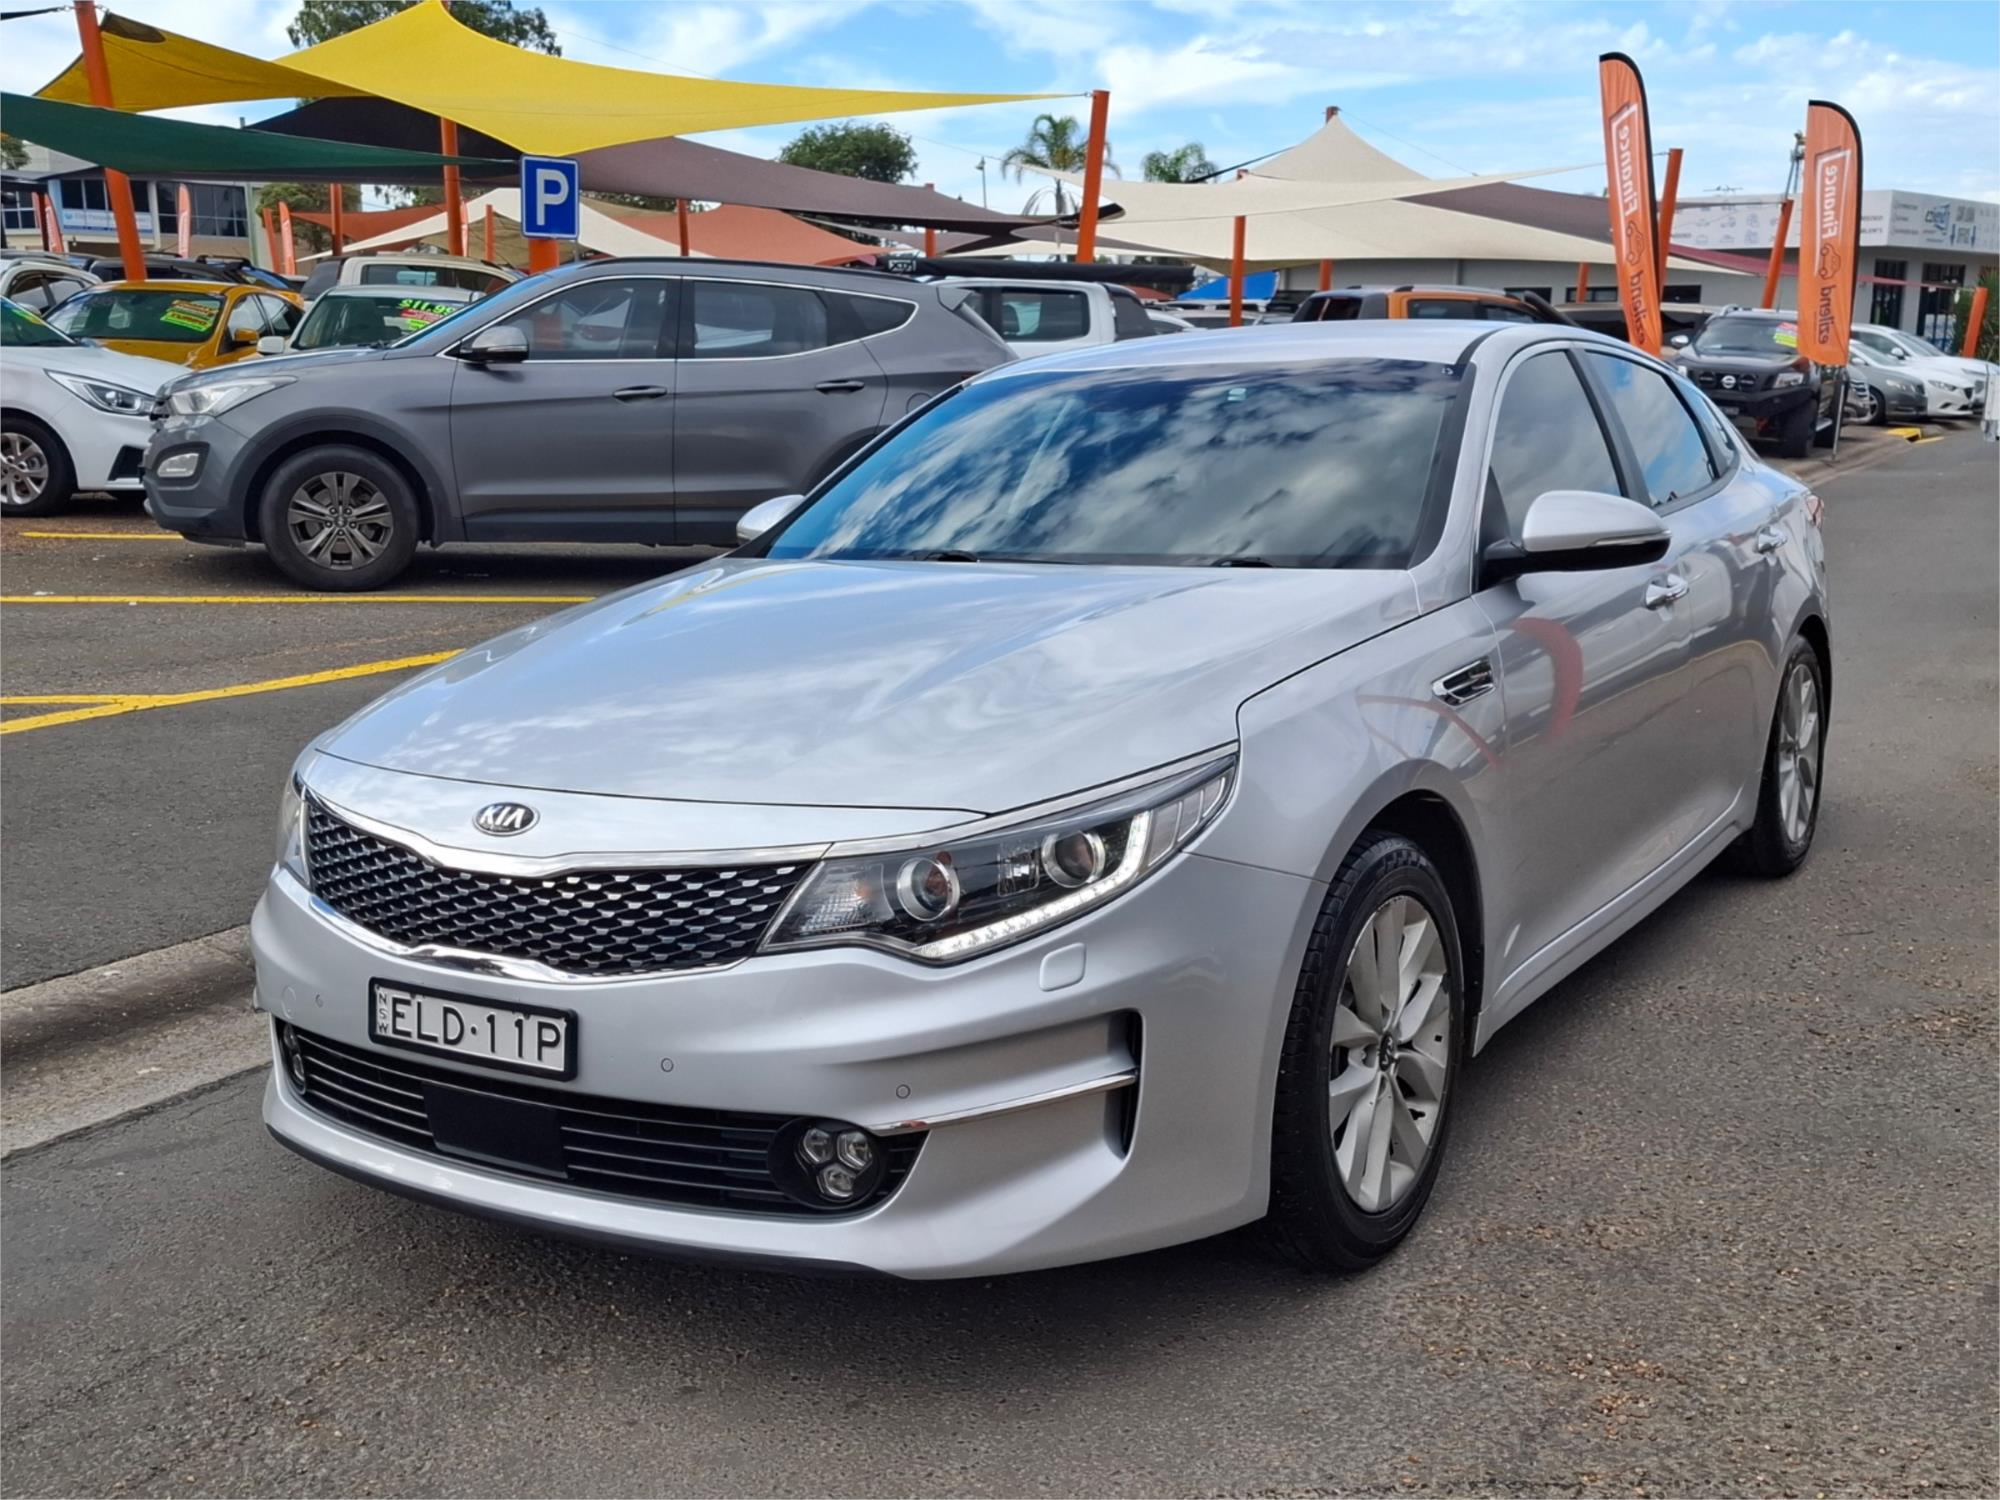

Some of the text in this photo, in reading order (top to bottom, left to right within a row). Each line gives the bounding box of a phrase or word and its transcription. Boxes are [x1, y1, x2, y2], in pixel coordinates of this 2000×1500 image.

[536, 168, 569, 226] P
[479, 805, 526, 829] KIA
[377, 993, 390, 1034] NSW
